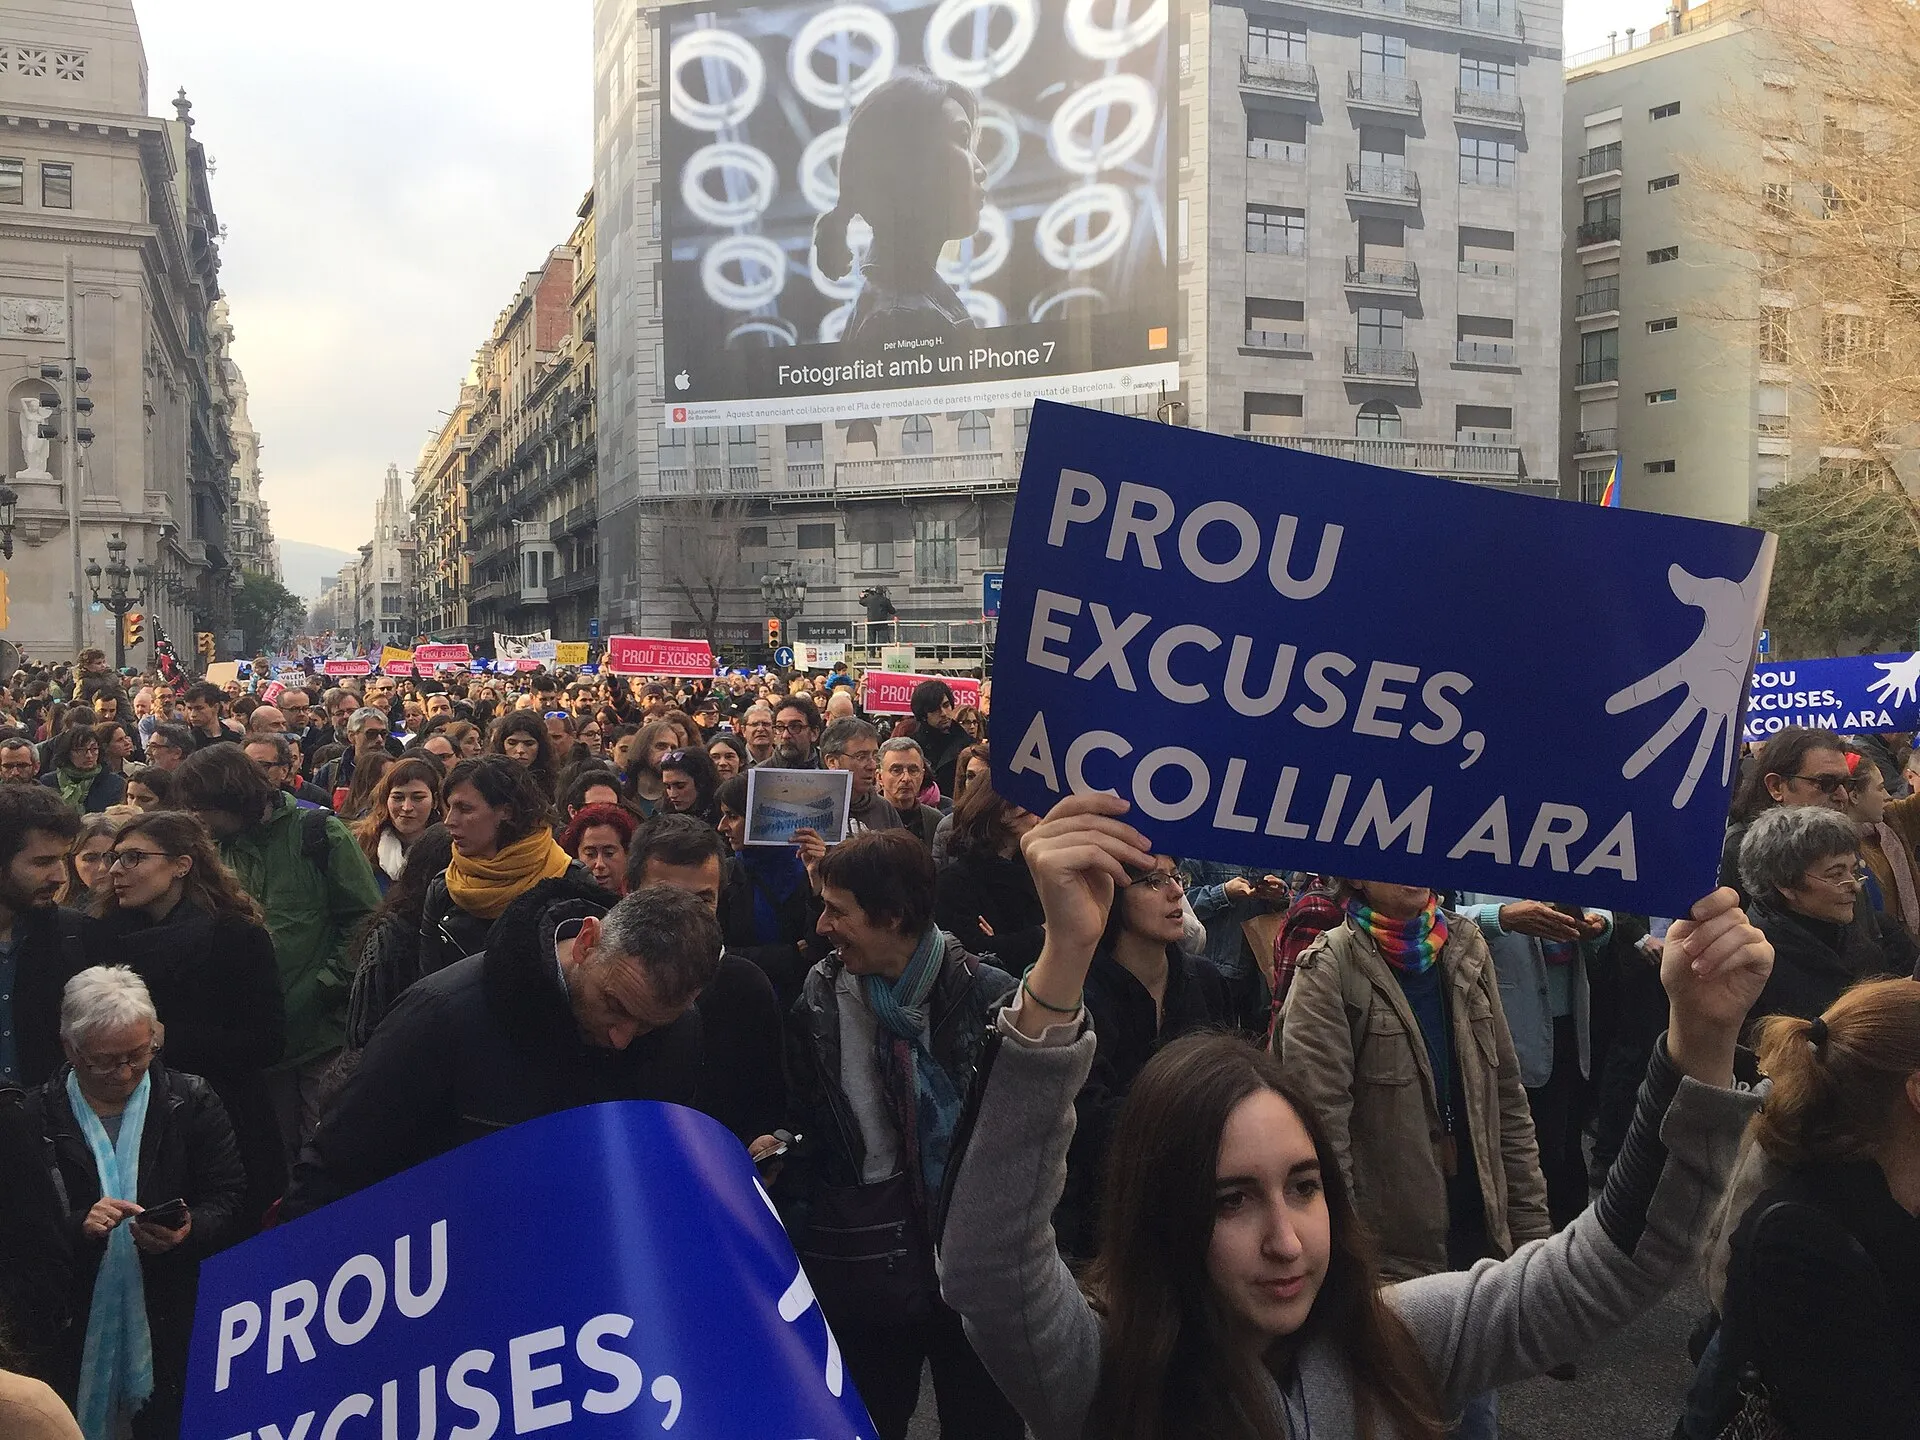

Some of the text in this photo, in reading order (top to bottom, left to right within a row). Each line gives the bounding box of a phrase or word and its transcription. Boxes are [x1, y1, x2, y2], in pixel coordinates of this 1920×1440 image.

[884, 336, 945, 351] per MingLung H.
[778, 341, 1056, 386] Fotografiat amb un iPhone 7
[726, 410, 754, 419] Aquest
[755, 408, 795, 417] anunciant
[847, 403, 855, 411] el
[856, 402, 870, 411] Pla
[871, 401, 881, 409] de
[933, 396, 944, 405] de
[945, 394, 972, 405] parets
[973, 392, 1010, 403] mitgeres
[1011, 390, 1022, 398] de
[1023, 389, 1032, 397] la
[1033, 387, 1058, 397] ciutat
[1059, 386, 1070, 394] de
[1072, 382, 1116, 394] Barcelona.
[1048, 468, 1344, 600] PROU
[689, 628, 724, 638] BURER
[622, 649, 654, 663] PROU
[658, 651, 711, 667] EXCUSES
[880, 685, 915, 702] PROU
[1026, 589, 1486, 769] EXCUSES,
[1751, 671, 1796, 688] ROU
[1747, 690, 1843, 712] XCUSES,
[1843, 709, 1894, 728] ARA
[1009, 711, 1637, 881] ACOLLIM ARA
[215, 1219, 448, 1393] PROU
[220, 1312, 682, 1440] USES,
